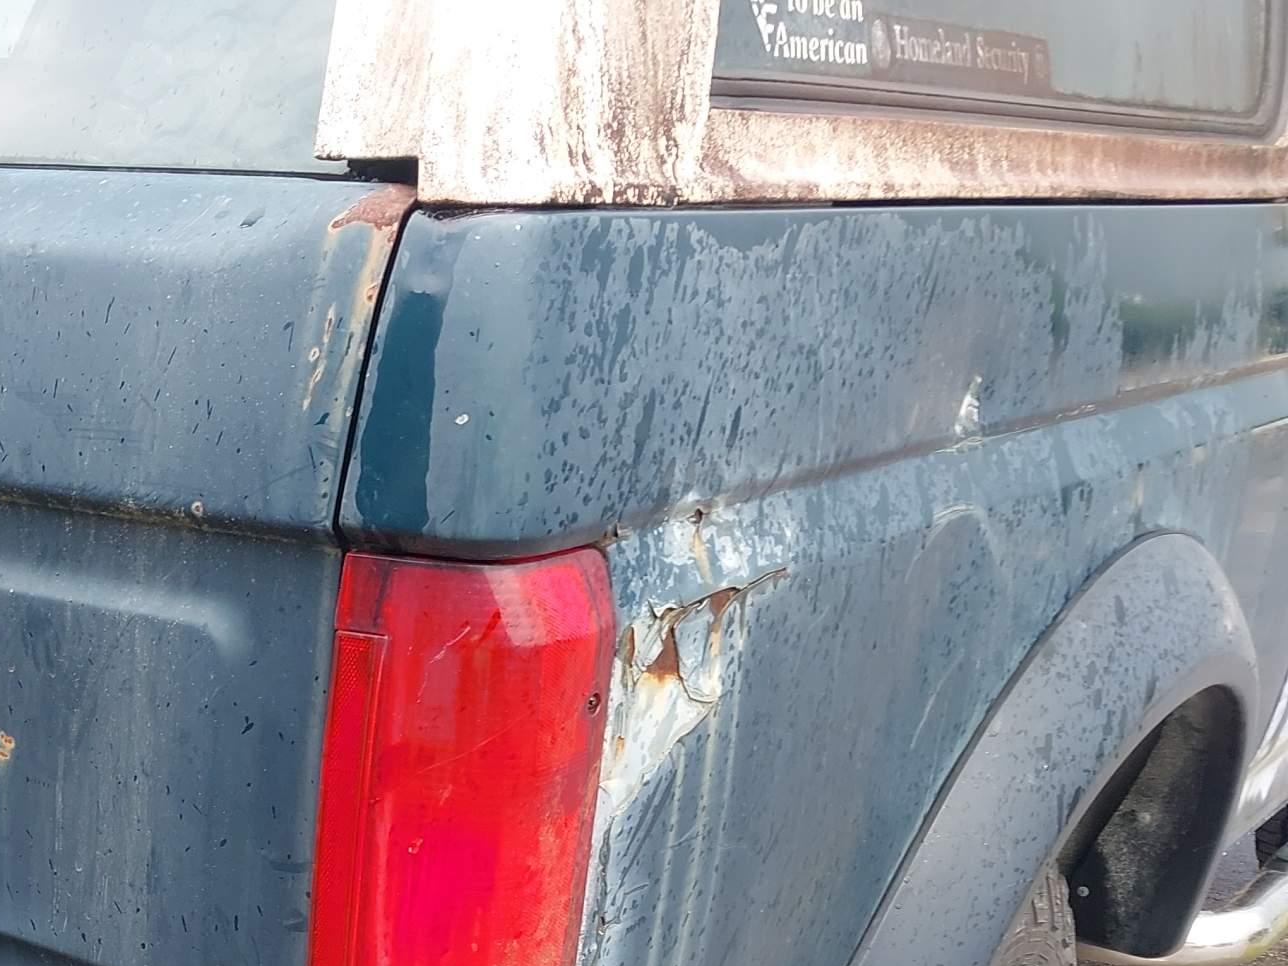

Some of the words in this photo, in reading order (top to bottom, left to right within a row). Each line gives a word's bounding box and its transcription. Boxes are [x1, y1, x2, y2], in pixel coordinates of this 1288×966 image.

[773, 21, 868, 64] American
[893, 24, 972, 67] Homeland
[976, 36, 1031, 85] Security
